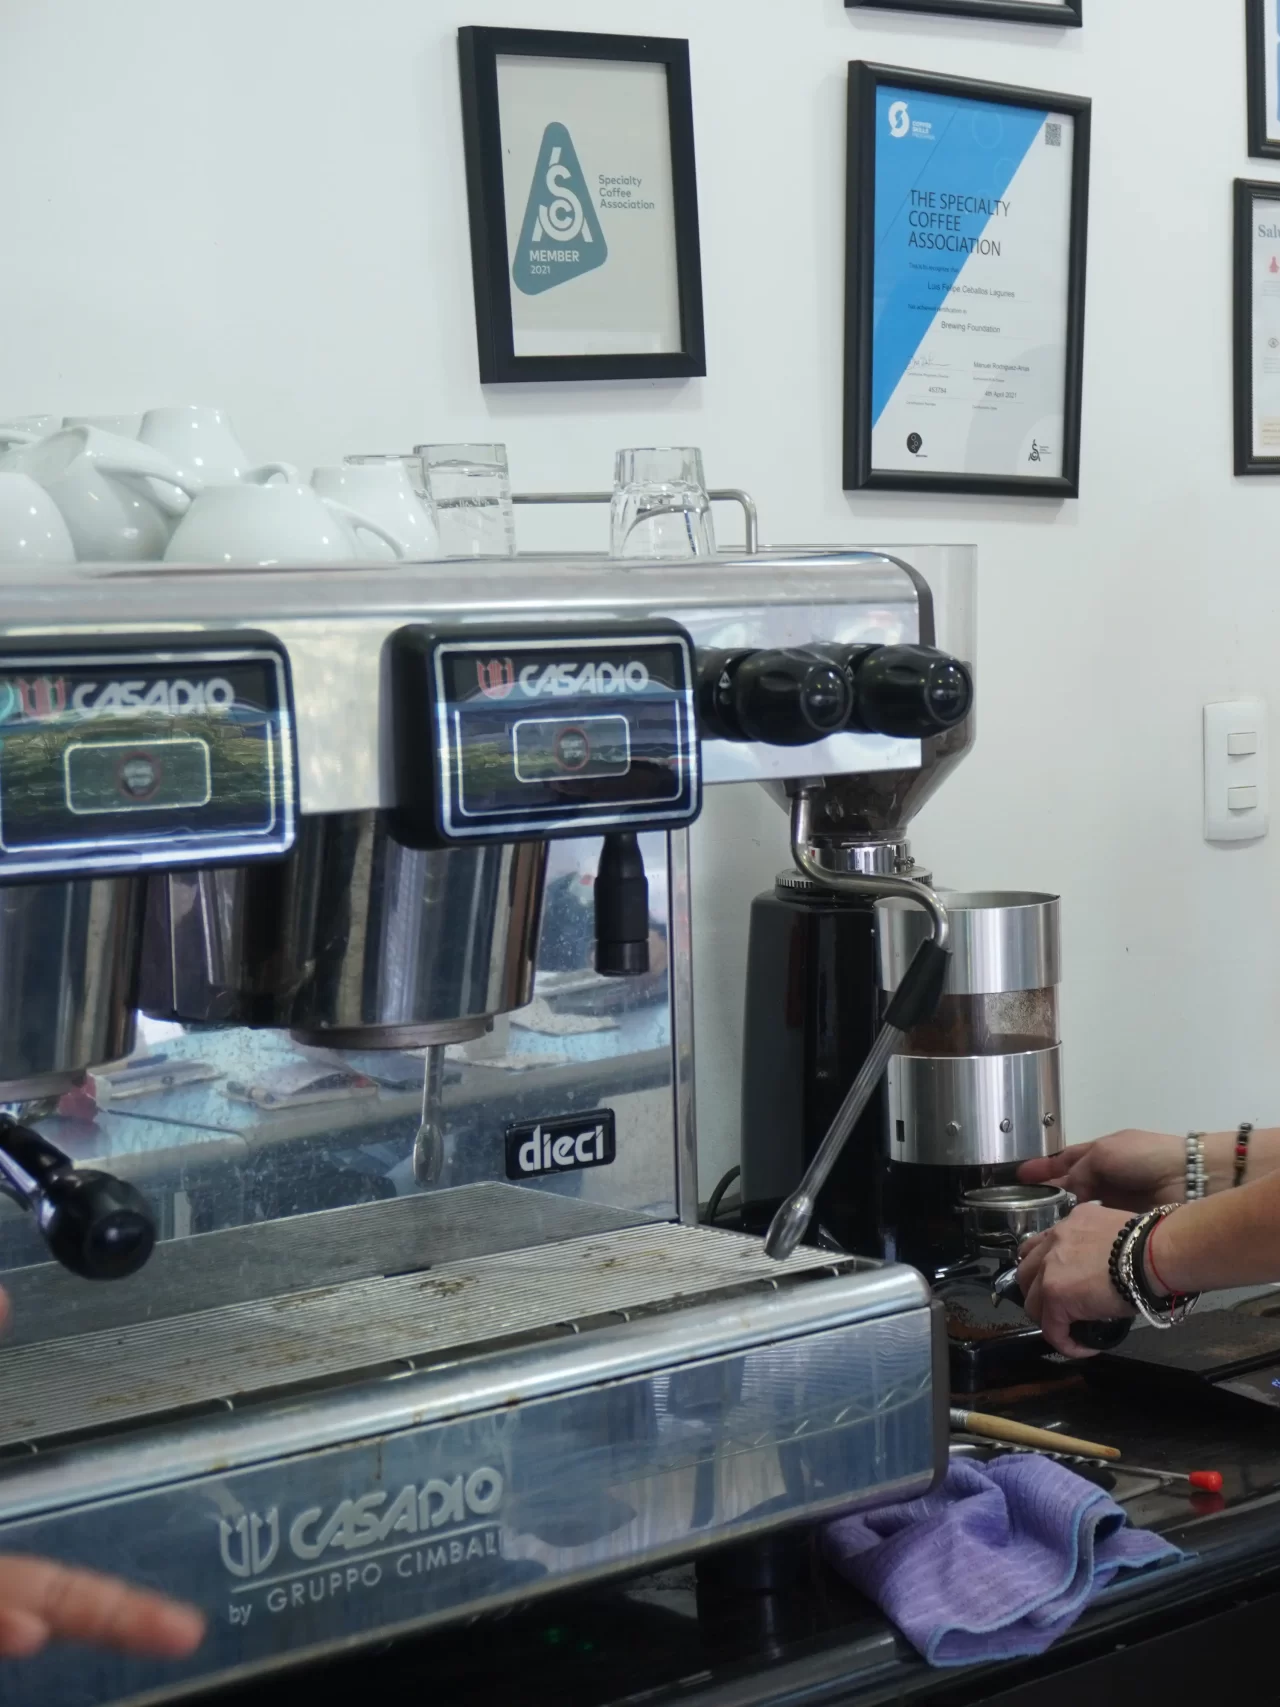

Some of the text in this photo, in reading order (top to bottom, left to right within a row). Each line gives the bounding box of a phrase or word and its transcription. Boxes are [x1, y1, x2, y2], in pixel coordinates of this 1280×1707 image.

[598, 174, 642, 187] Specialty
[599, 187, 632, 198] Coffee
[910, 189, 1011, 217] THE SPECIALTY
[600, 198, 655, 209] Association
[908, 210, 961, 231] COFFEE
[908, 231, 1001, 256] ASSOCIATION
[529, 250, 580, 262] MEMBER
[530, 265, 551, 275] 2021
[928, 281, 940, 291] Luis
[942, 283, 960, 294] Felipe
[962, 285, 988, 295] Ceballos
[941, 320, 1001, 333] Brewing Foundation
[518, 661, 649, 697] CASADIO
[72, 678, 235, 719] CASADIO
[518, 1124, 604, 1171] dieci
[289, 1466, 503, 1561] CASADIO
[228, 1603, 253, 1626] by
[267, 1562, 382, 1613] GRUPPO
